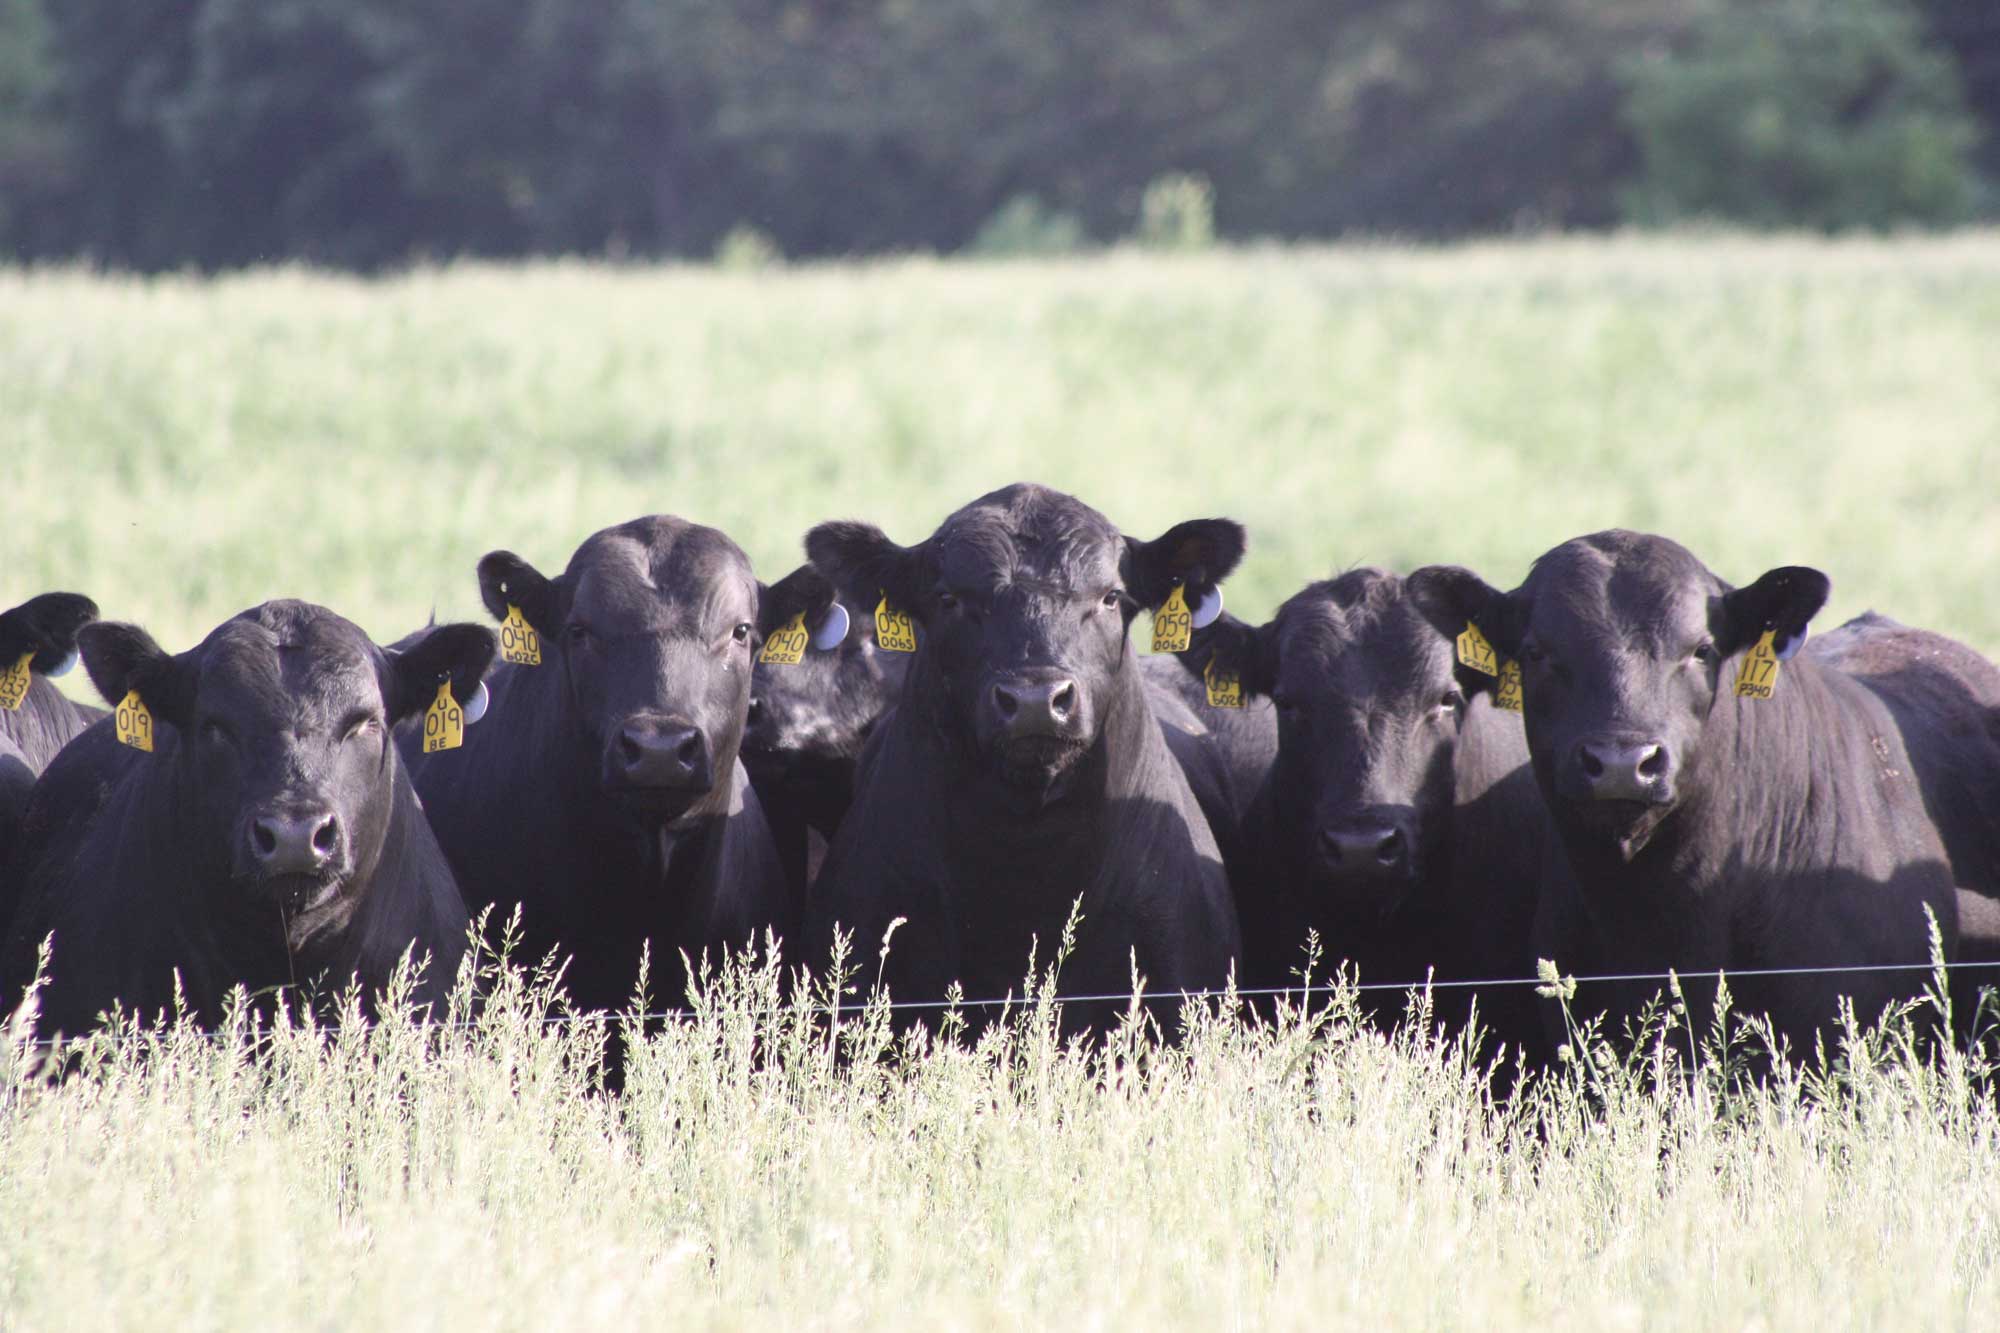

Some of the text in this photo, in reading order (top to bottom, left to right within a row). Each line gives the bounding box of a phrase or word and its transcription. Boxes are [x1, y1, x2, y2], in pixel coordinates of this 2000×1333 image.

[878, 611, 912, 637] 059
[1155, 611, 1189, 637] 059
[502, 626, 538, 653] 040
[767, 632, 805, 652] 040
[1462, 637, 1492, 662] 117
[1741, 658, 1774, 682] 117
[119, 708, 148, 737] 019
[426, 707, 460, 736] 019
